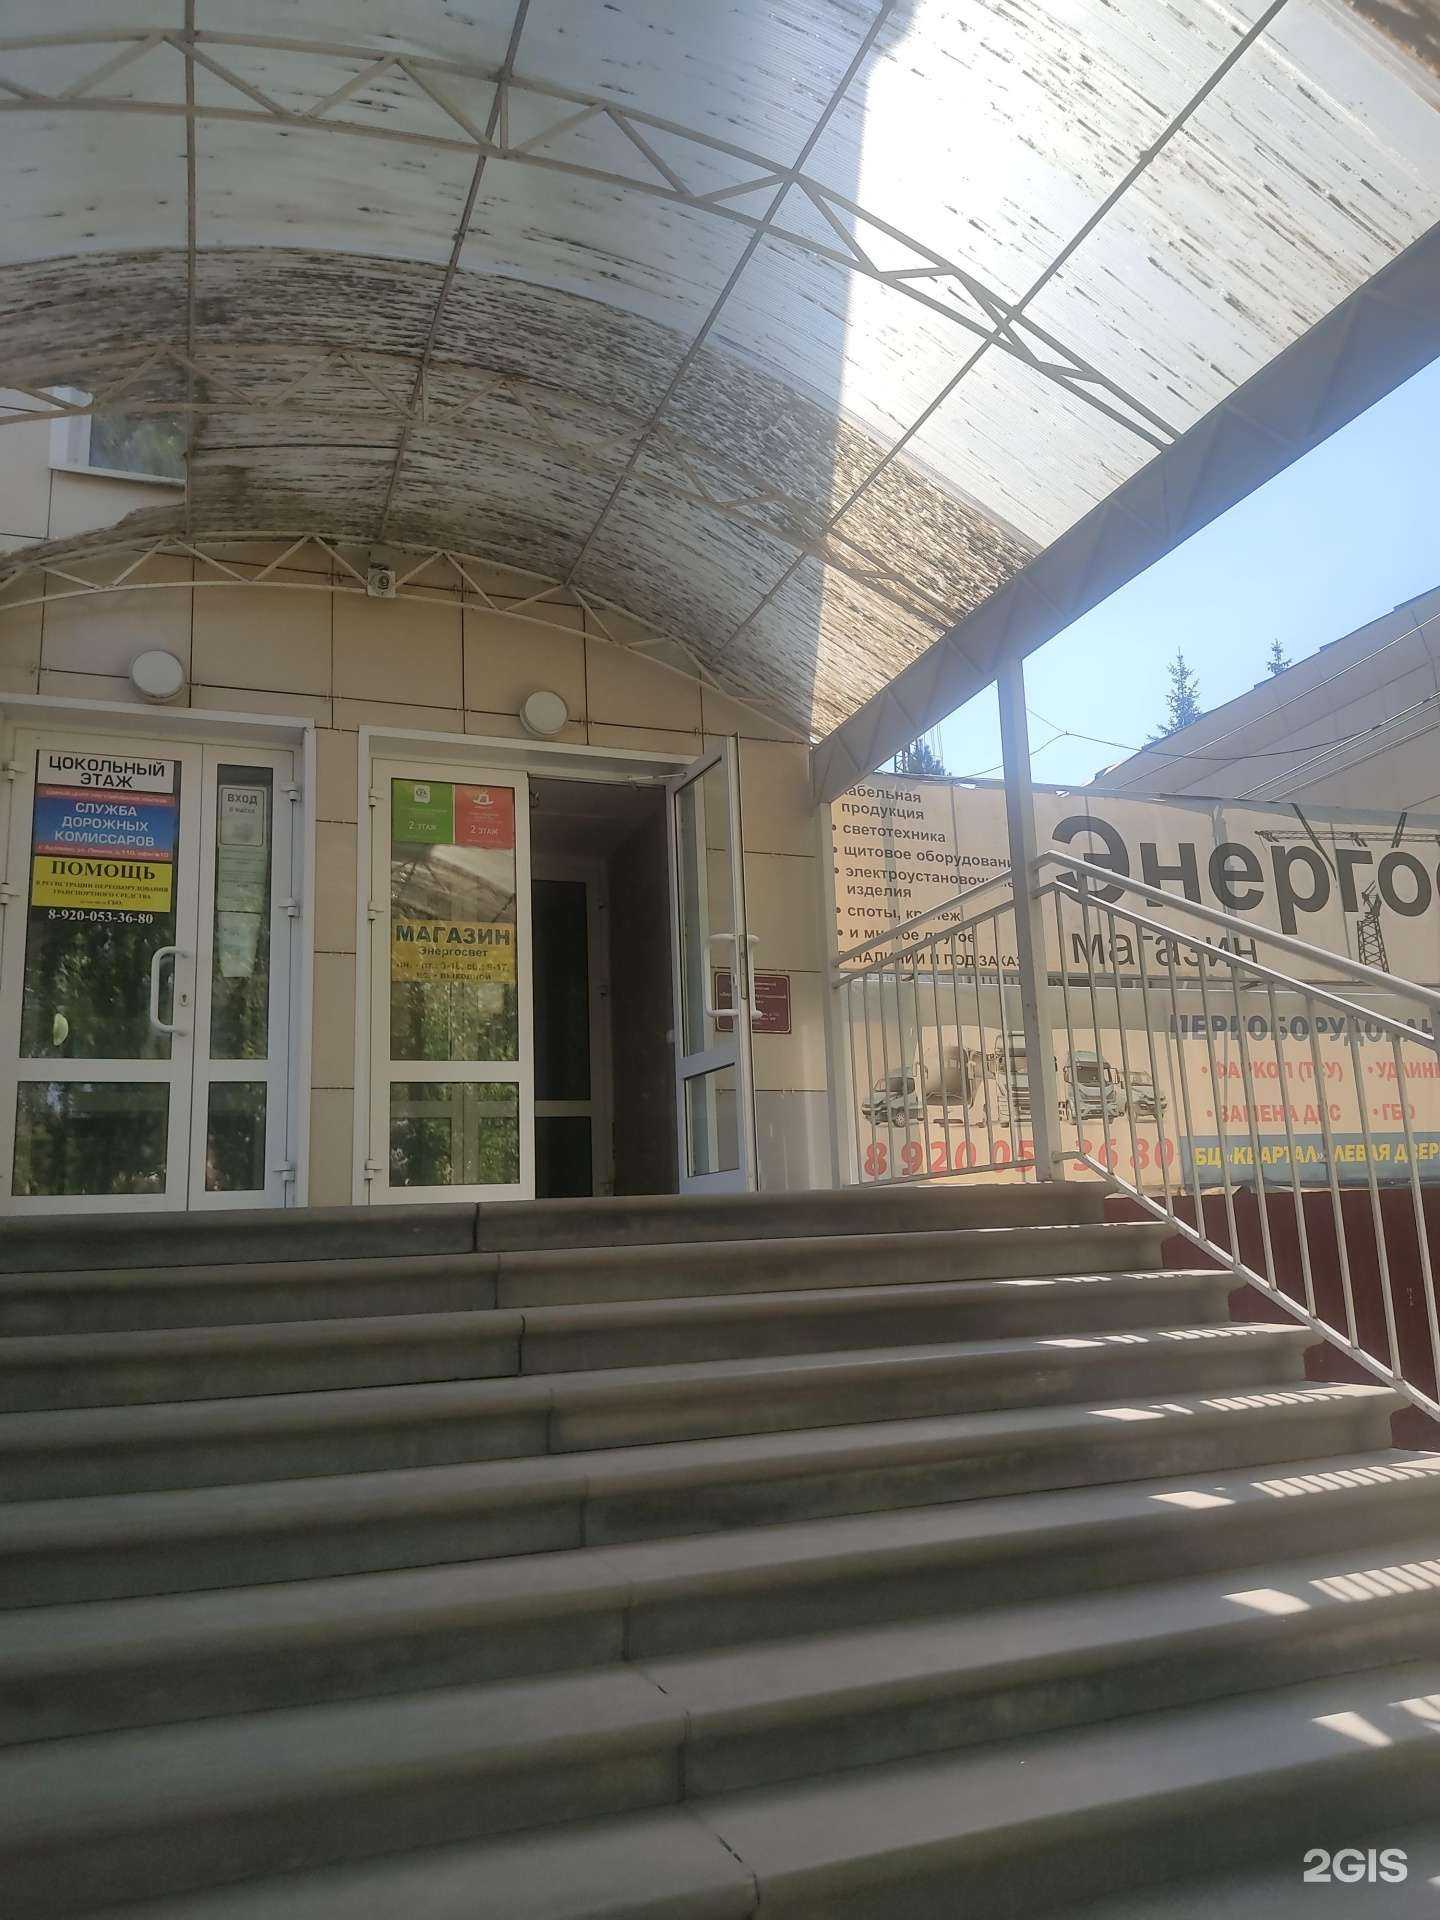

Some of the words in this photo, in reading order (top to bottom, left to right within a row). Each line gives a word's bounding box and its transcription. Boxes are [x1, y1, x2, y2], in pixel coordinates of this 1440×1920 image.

[49, 755, 165, 777] ЦОКОЛЬНЫЙ
[80, 773, 133, 788] ЭТАЖ
[227, 793, 257, 805] ВХОД
[845, 785, 921, 803] абельная
[75, 802, 137, 816] СЛУЖБА
[842, 803, 924, 820] продукция
[62, 816, 149, 832] ДОРОЖНЫХ
[54, 831, 155, 847] КОМИССАРОВ
[843, 824, 946, 843] светотехника
[844, 845, 912, 861] щитовое
[51, 860, 155, 881] ПОМОЩЬ
[1052, 815, 1440, 934] Энерго
[847, 885, 912, 898] изделия
[48, 909, 153, 924] 8-920-053-36-80
[847, 907, 901, 921] споты,
[906, 909, 961, 922] креж
[396, 925, 510, 945] МАГАЗИН
[850, 930, 859, 938] и
[864, 930, 919, 941] мное
[925, 931, 974, 945] дугое
[418, 945, 488, 958] Энергосвет
[853, 951, 925, 965] НАЛИИИ
[944, 955, 976, 968] ПОД
[979, 955, 1019, 967] ЗАКА
[1216, 1060, 1294, 1079] ФАКОП
[1298, 1062, 1343, 1081] (ТУ)
[1303, 1104, 1341, 1124] ДС
[865, 1142, 888, 1176] 8
